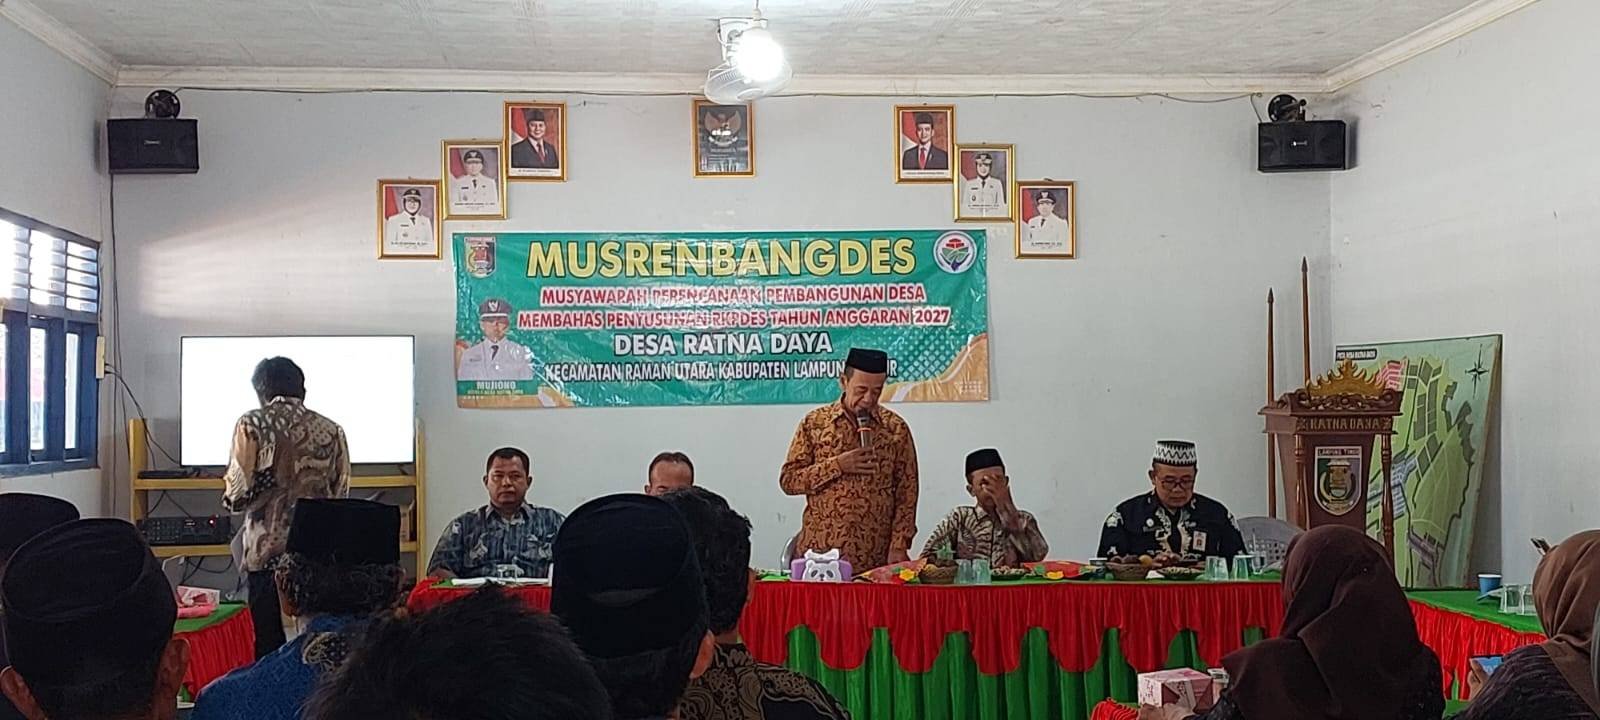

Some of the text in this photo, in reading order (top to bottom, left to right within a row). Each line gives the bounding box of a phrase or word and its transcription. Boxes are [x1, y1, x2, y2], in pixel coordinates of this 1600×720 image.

[526, 238, 916, 278] MUSRENBANGDES
[541, 286, 648, 305] MUSYAWARAH
[766, 285, 884, 303] PEMBANGUNAN
[888, 284, 926, 301] DESA
[518, 308, 950, 329] MEMBAHAS PENYUSUNAN RKPDES TAHUN ANGGARAN 2027
[613, 331, 834, 356] DESA RATNA DAYA
[546, 360, 845, 382] KECAMATAN RAMAN UTARA KABUPATEN LAMPUN
[1310, 418, 1347, 430] RATNA
